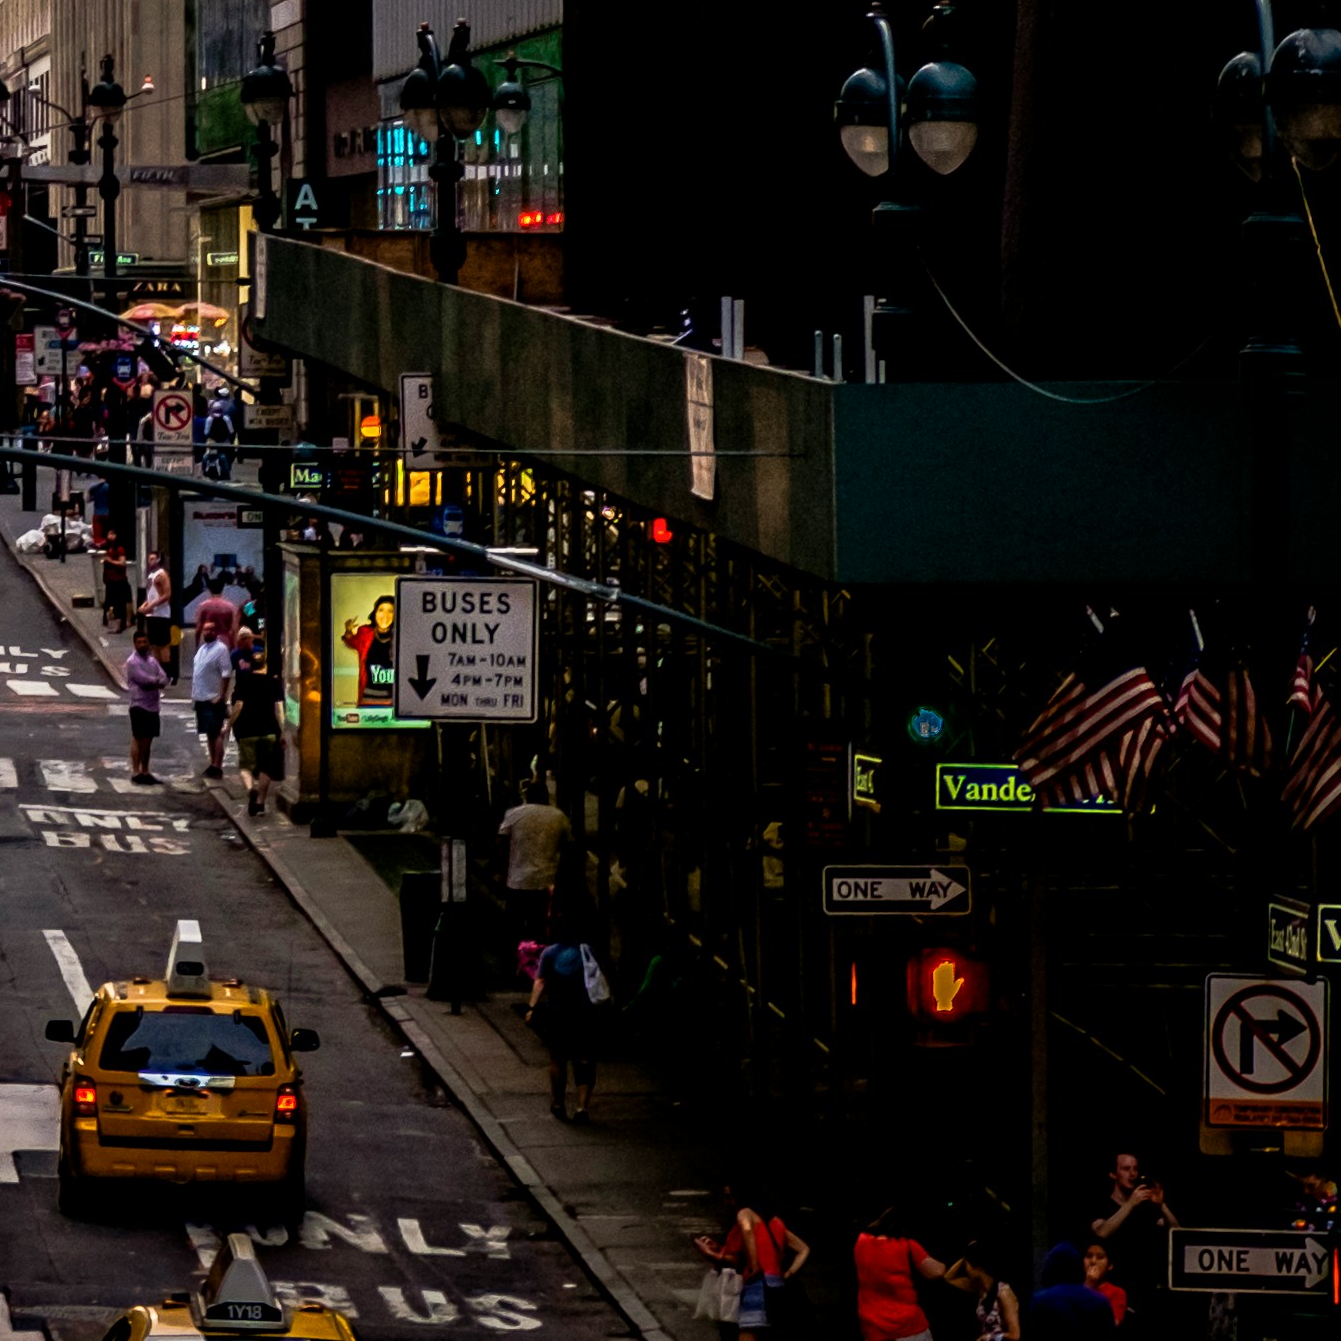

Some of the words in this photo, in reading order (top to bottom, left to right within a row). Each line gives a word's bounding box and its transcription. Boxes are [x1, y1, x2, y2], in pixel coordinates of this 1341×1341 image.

[133, 281, 182, 293] ZARA
[422, 592, 510, 614] BUSES
[432, 623, 500, 644] ONLY
[441, 694, 467, 706] MON
[476, 697, 497, 706] THRU
[504, 694, 524, 706] FRI
[40, 830, 192, 855] BUS
[837, 881, 883, 899] ONE
[909, 881, 953, 899] WAY
[1198, 1248, 1250, 1271] ONE
[1275, 1250, 1329, 1275] WAY
[226, 1304, 262, 1319] 1Y18
